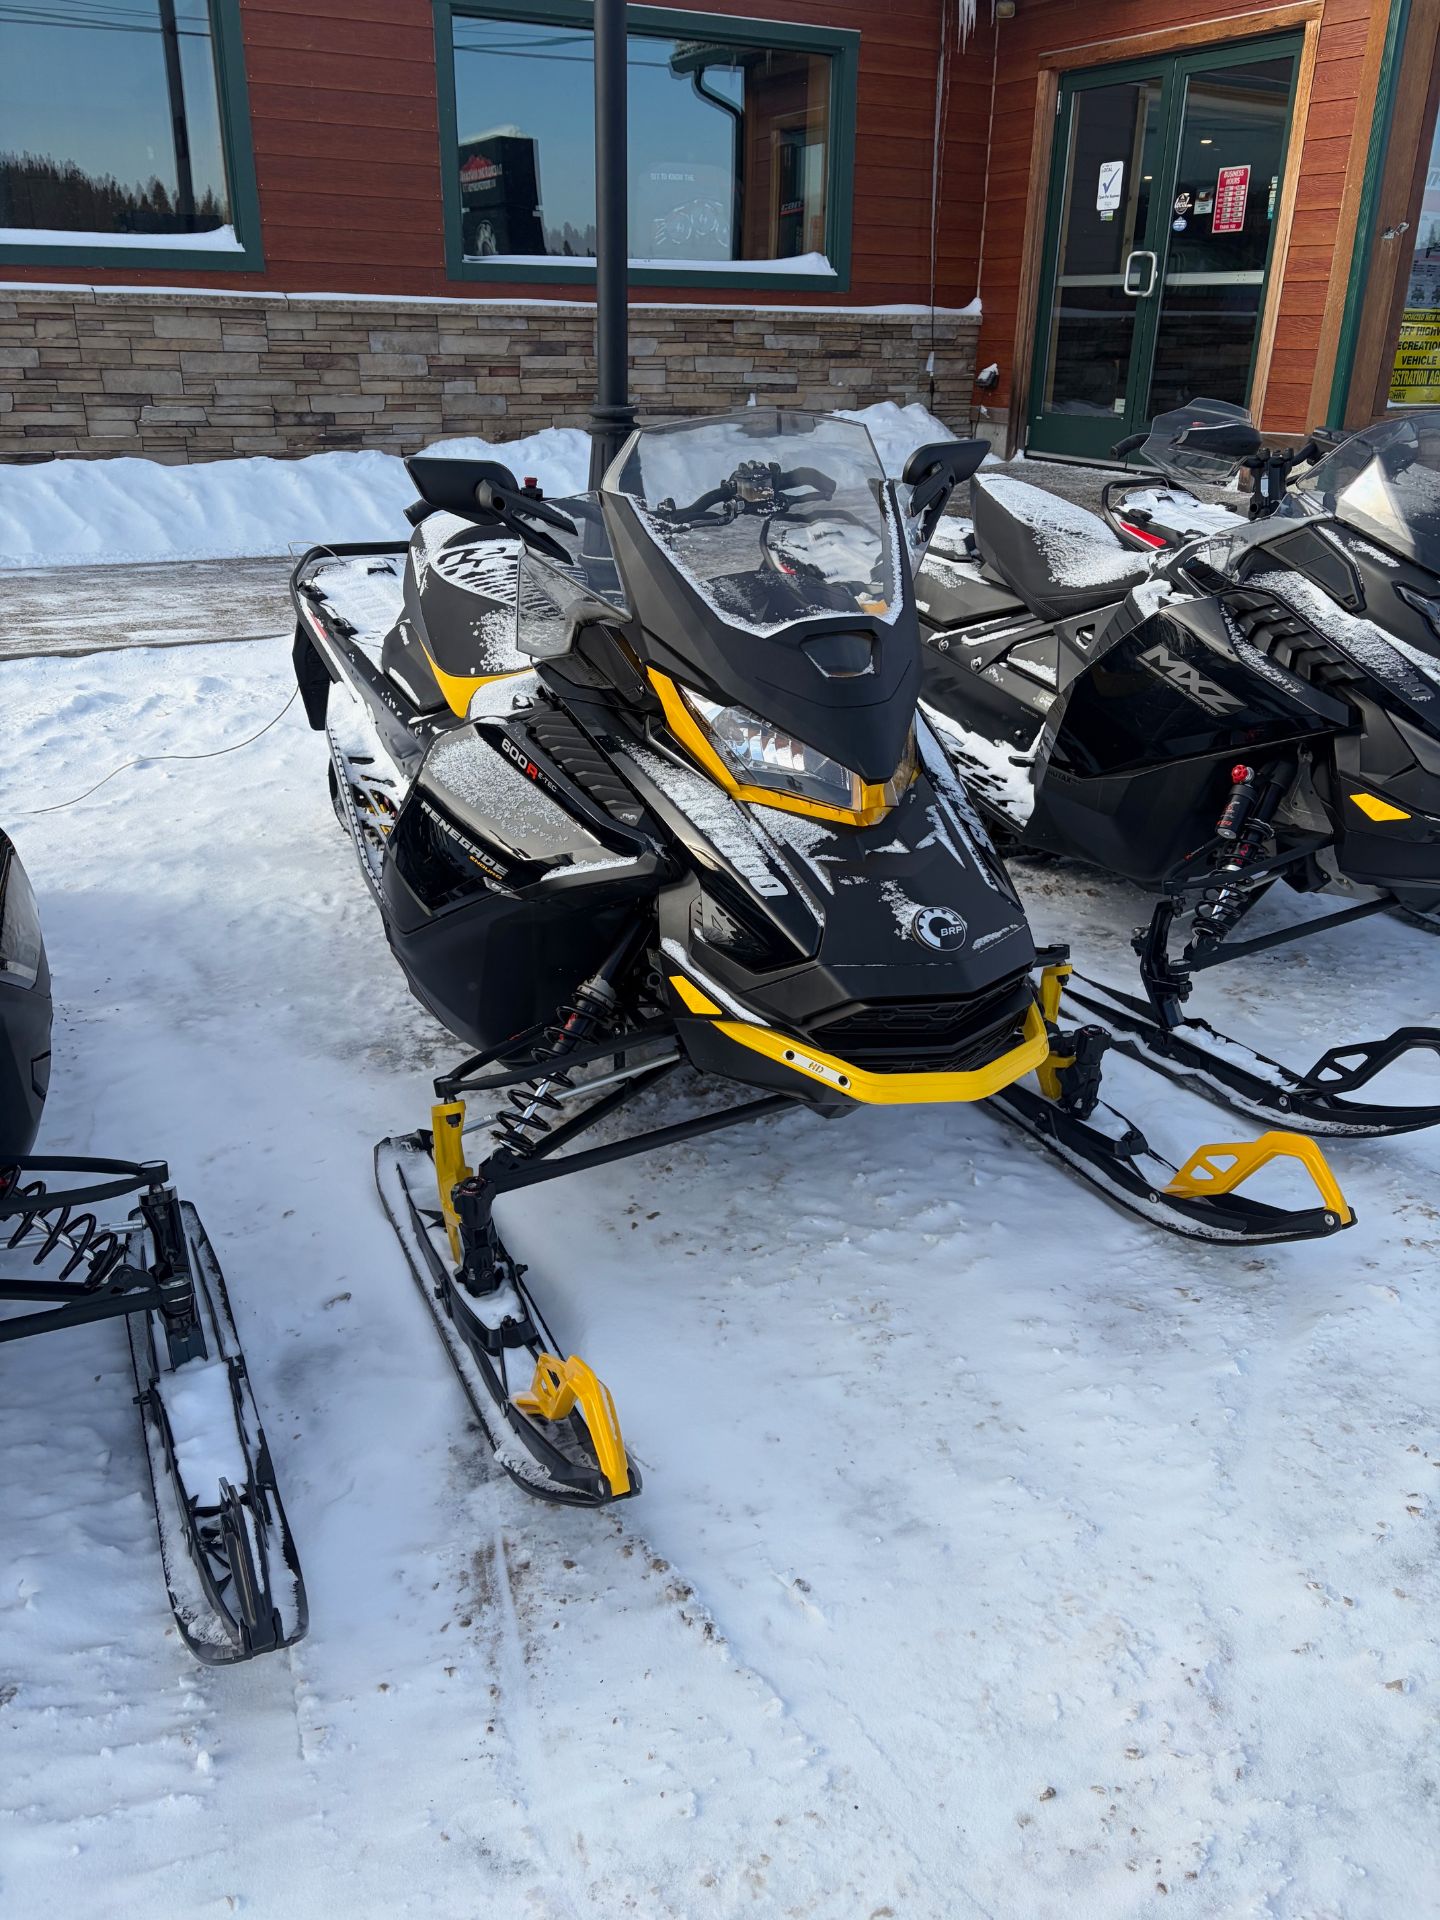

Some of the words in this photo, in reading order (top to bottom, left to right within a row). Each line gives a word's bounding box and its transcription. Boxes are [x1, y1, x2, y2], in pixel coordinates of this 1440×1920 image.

[1223, 169, 1245, 179] BUSINESS
[1225, 178, 1241, 186] HOURS
[1401, 355, 1437, 366] VEHICLE
[1141, 643, 1248, 714] MXZ
[537, 771, 557, 792] E-TEC
[420, 800, 508, 877] RENEGADE
[469, 855, 503, 880] ENDURO
[940, 925, 963, 937] BRP
[808, 1061, 825, 1074] HD
